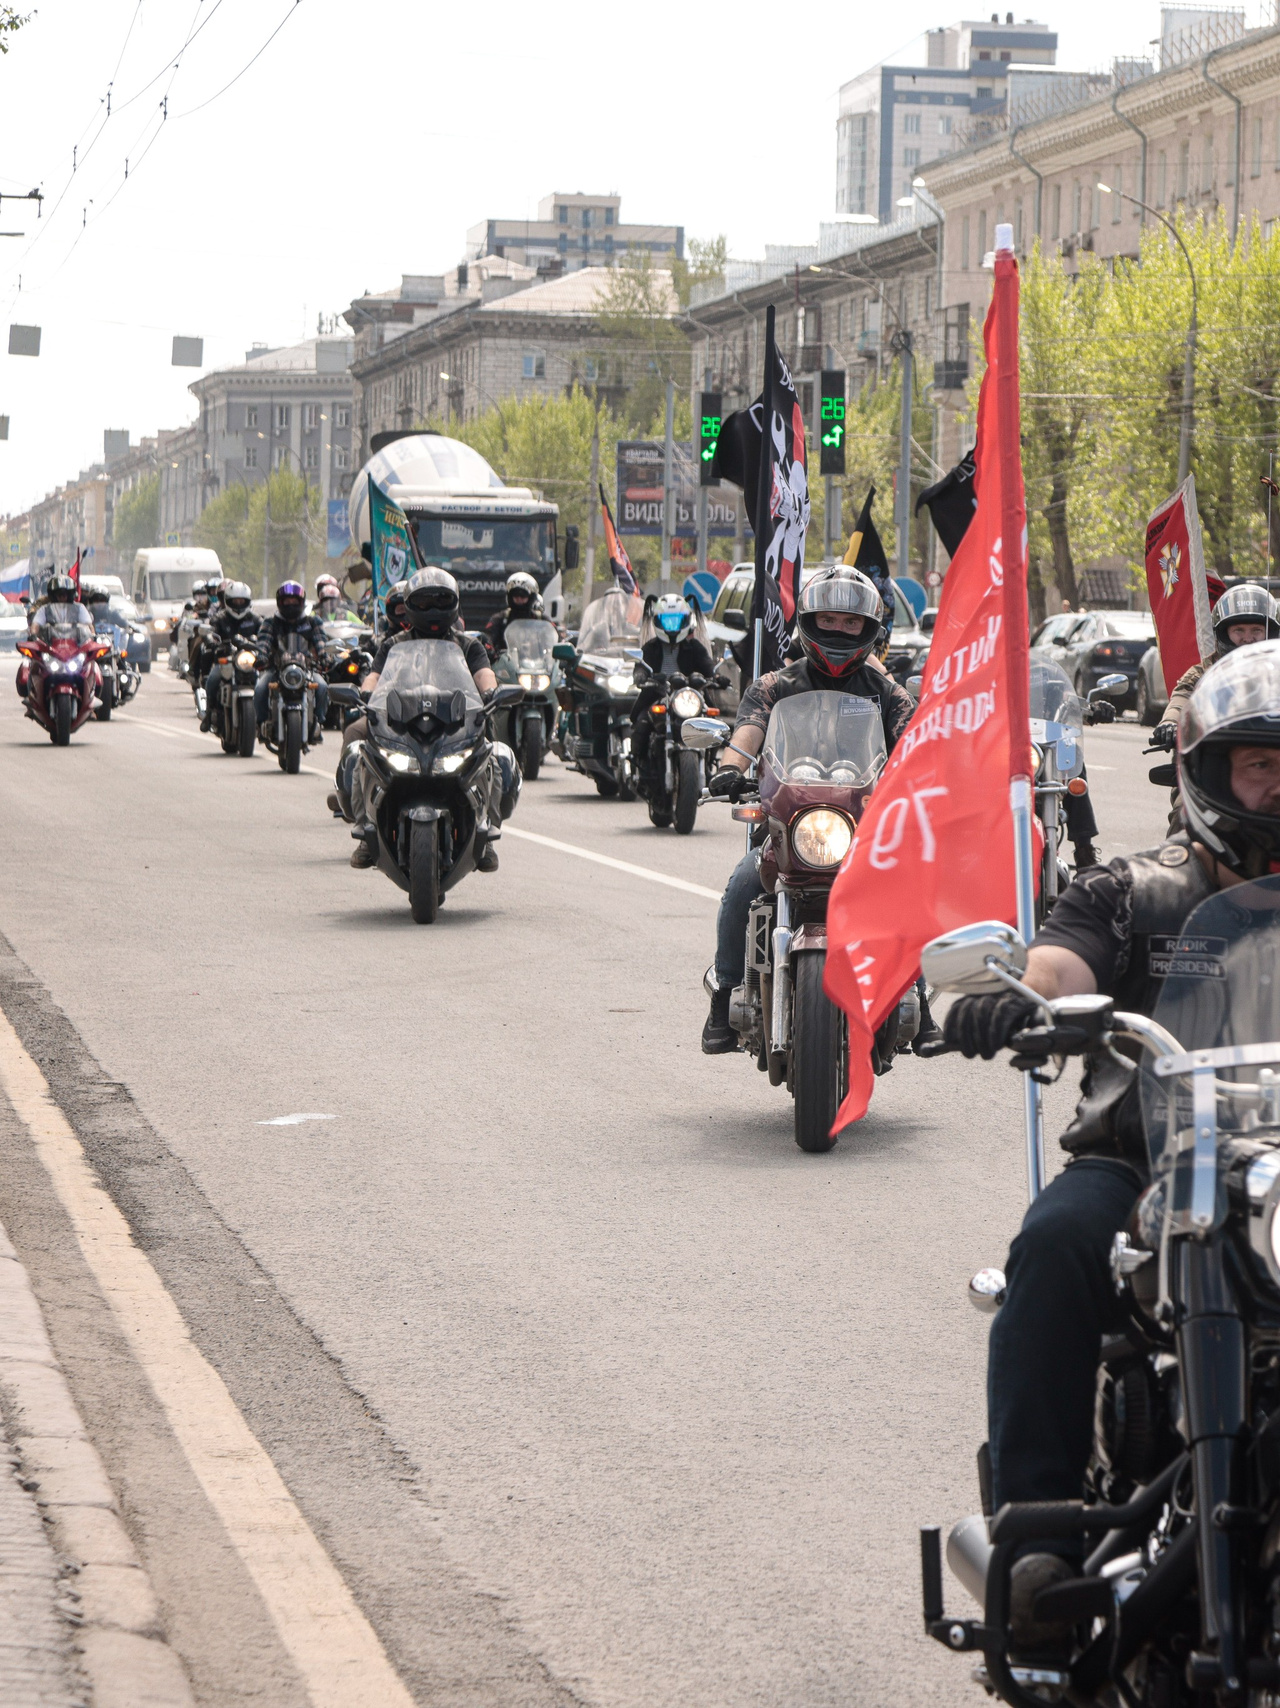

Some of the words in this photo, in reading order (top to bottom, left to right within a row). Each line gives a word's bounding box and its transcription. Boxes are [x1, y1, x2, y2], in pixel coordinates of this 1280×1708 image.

[821, 397, 845, 420] 26
[701, 417, 721, 437] 26
[1166, 940, 1208, 952] RUDIK
[1152, 960, 1220, 976] PRESIDENT
